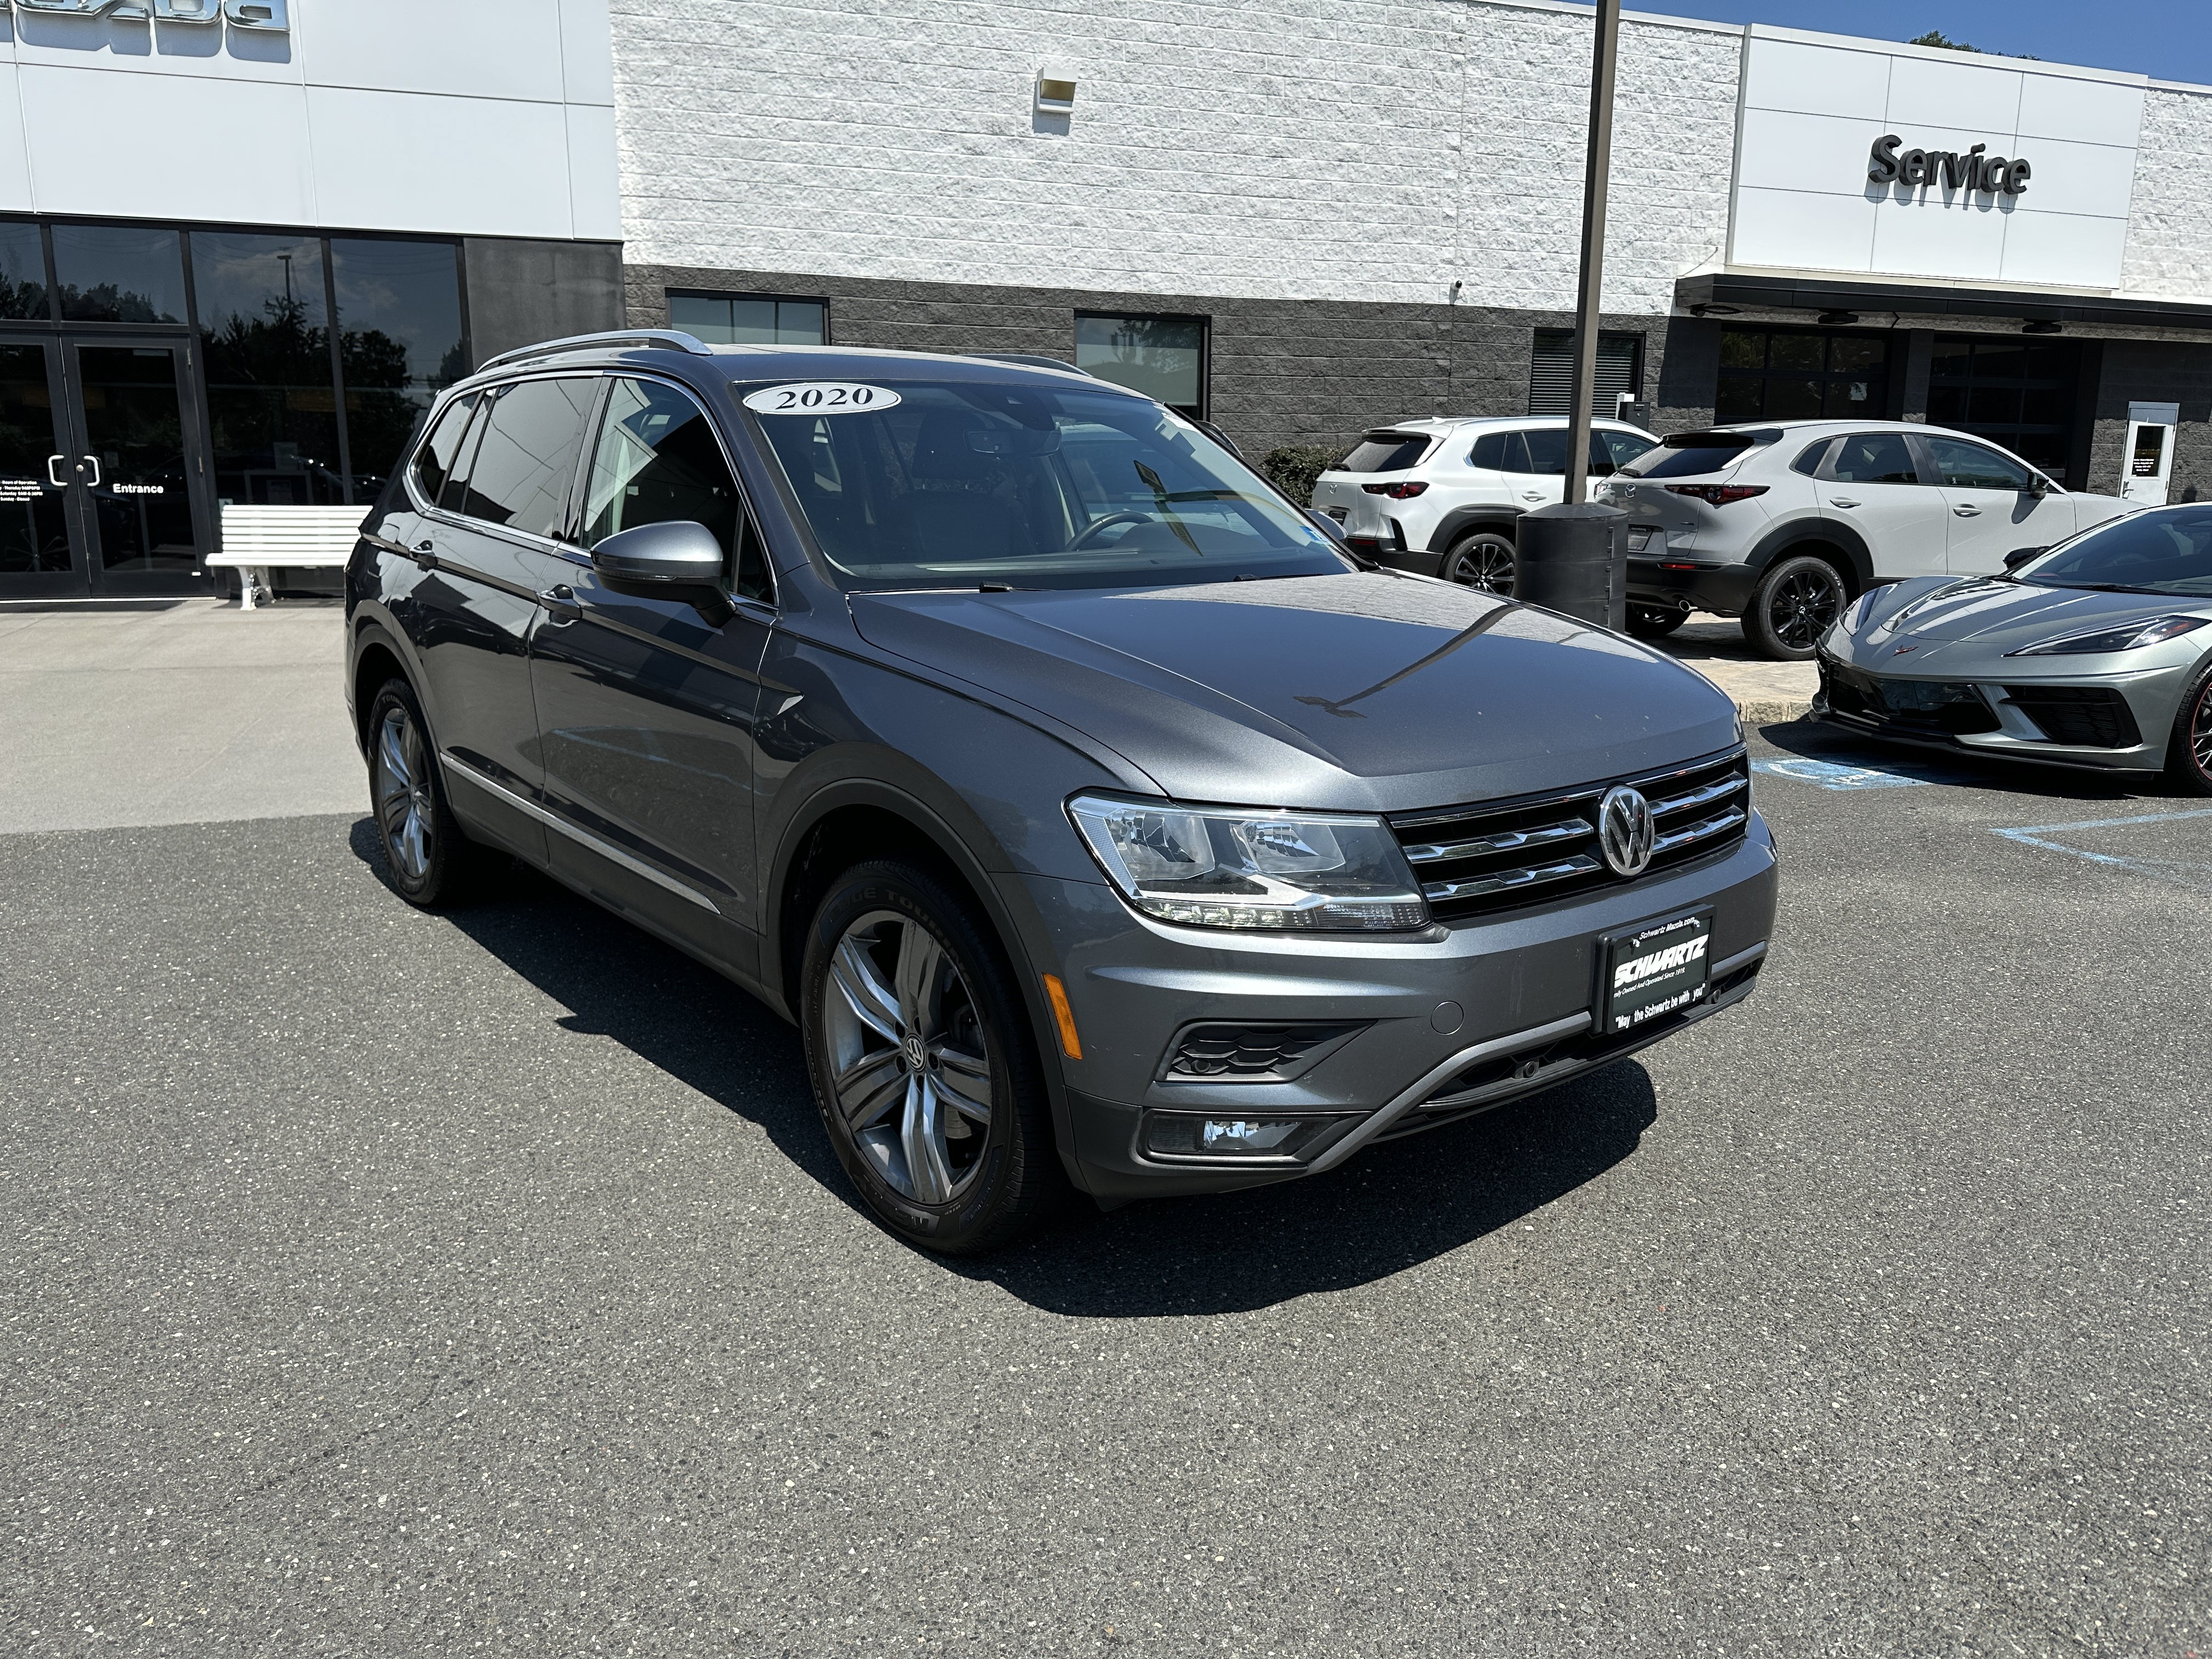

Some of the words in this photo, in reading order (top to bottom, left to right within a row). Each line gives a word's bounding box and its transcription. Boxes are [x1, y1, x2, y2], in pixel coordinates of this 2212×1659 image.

[1868, 134, 2032, 194] Service
[775, 388, 873, 410] 2020
[113, 483, 164, 494] Entrance
[1639, 926, 1666, 940] Schwartz
[1614, 934, 1709, 989] SCHWARTZ
[1637, 980, 1646, 990] And
[1645, 973, 1663, 986] Operated
[1663, 971, 1675, 980] Since
[1634, 1009, 1644, 1023] the
[1644, 998, 1671, 1019] Schwartz
[1671, 996, 1678, 1008] be
[1679, 990, 1690, 1005] with
